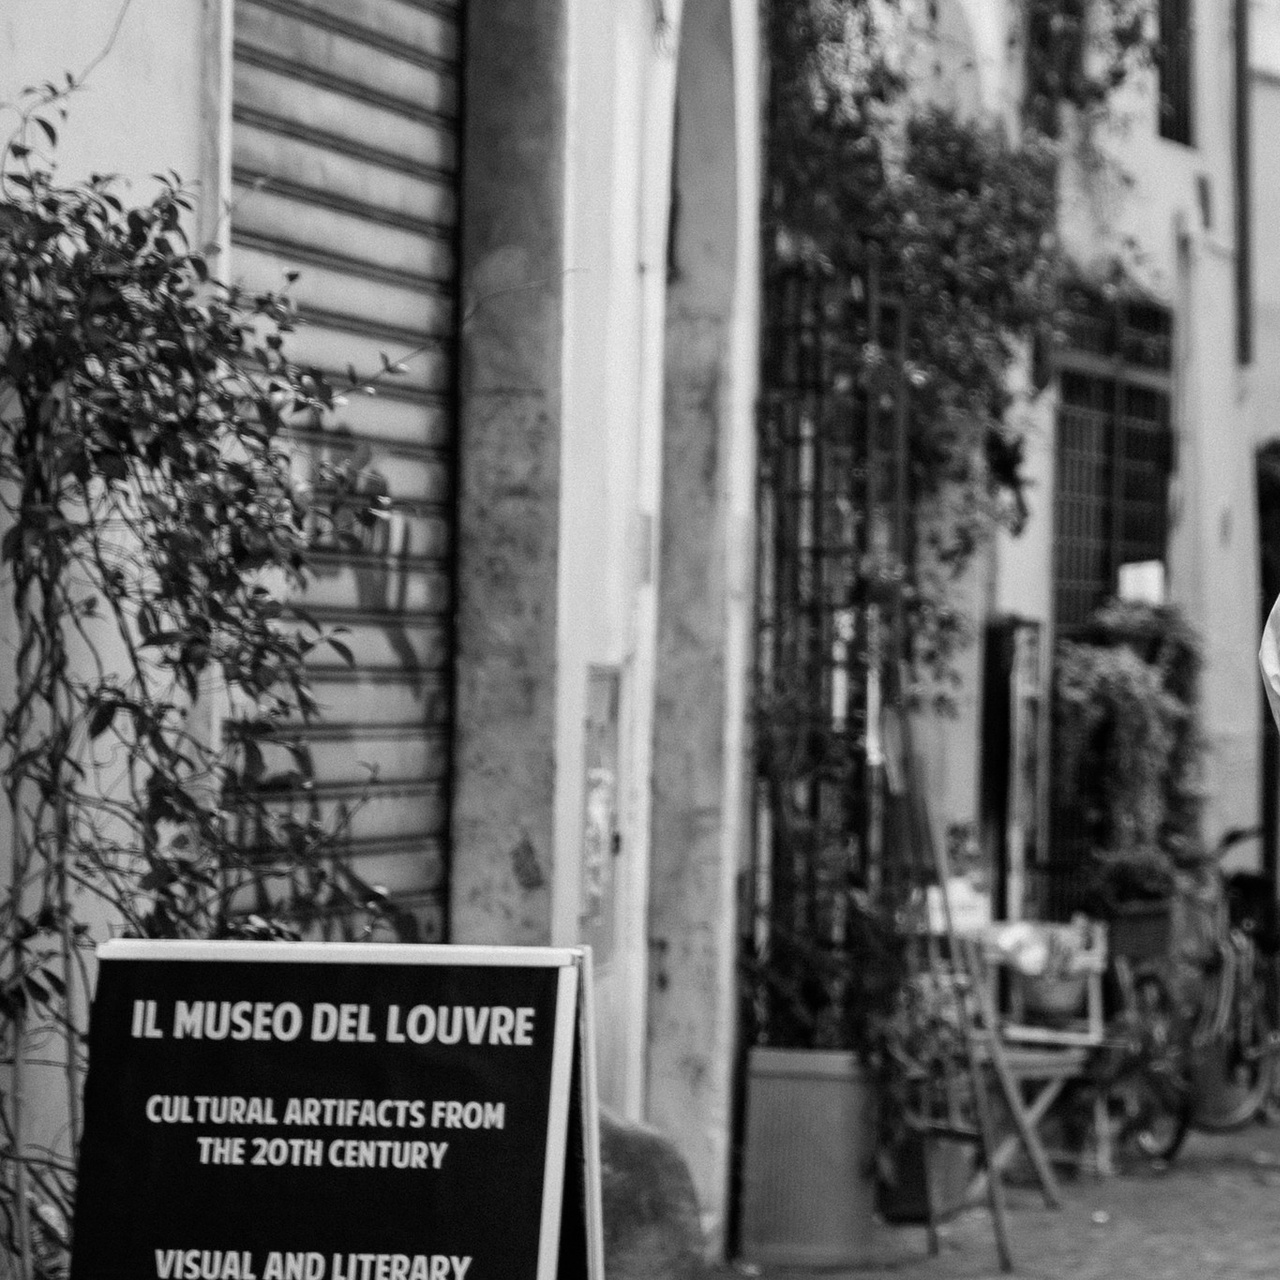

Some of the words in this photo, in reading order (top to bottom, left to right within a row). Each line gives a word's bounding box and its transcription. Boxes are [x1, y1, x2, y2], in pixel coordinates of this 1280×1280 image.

[132, 1000, 163, 1038] IL
[173, 1001, 302, 1041] MUSEO
[311, 1003, 376, 1042] DEL
[387, 1005, 535, 1045] LOUVRE
[146, 1095, 277, 1124] CULTURAL
[283, 1098, 425, 1128] ARTIFACTS
[431, 1101, 505, 1129] FROM
[197, 1137, 245, 1164] THE
[251, 1138, 323, 1166] 20TH
[329, 1139, 448, 1169] CENTURY
[156, 1249, 256, 1280] VISUAL
